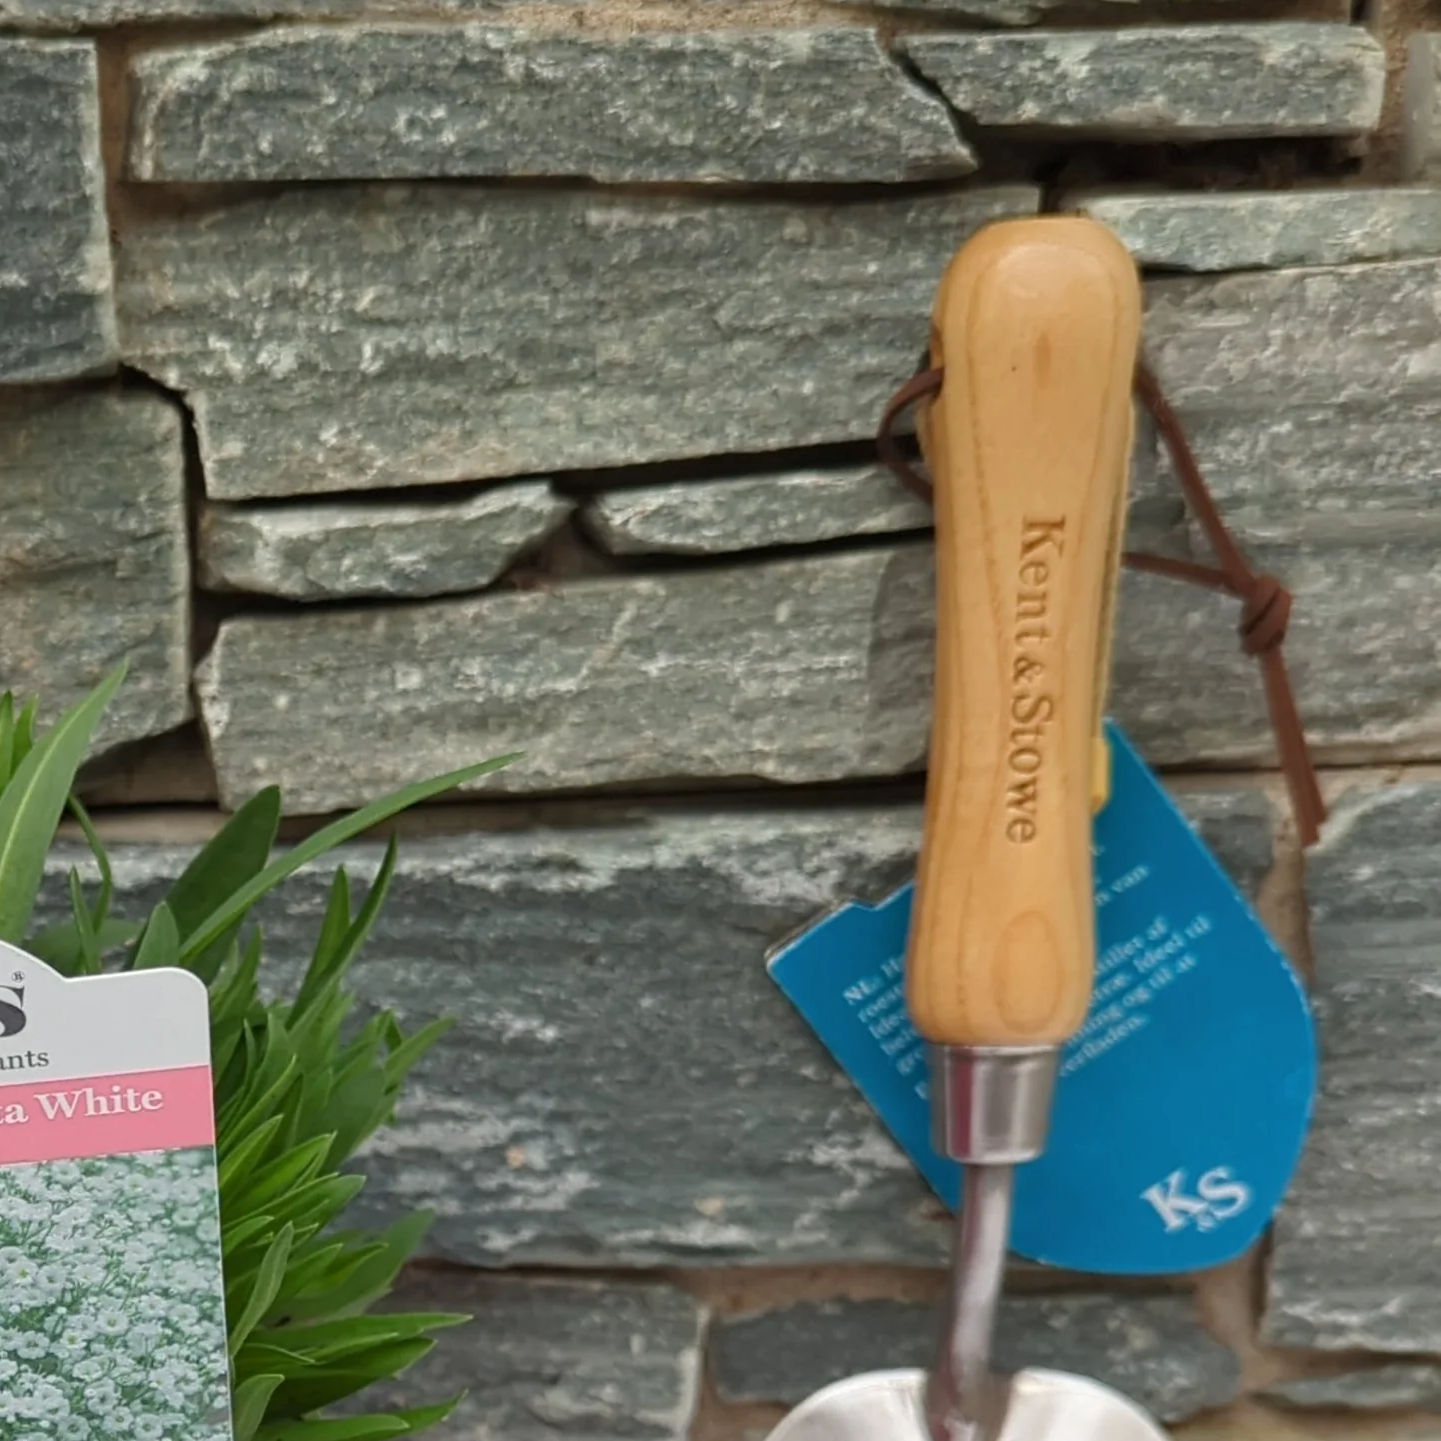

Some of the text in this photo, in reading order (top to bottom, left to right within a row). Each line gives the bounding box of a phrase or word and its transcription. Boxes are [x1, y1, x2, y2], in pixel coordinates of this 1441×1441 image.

[1005, 514, 1066, 844] Kent & Stowe
[34, 1085, 164, 1121] White
